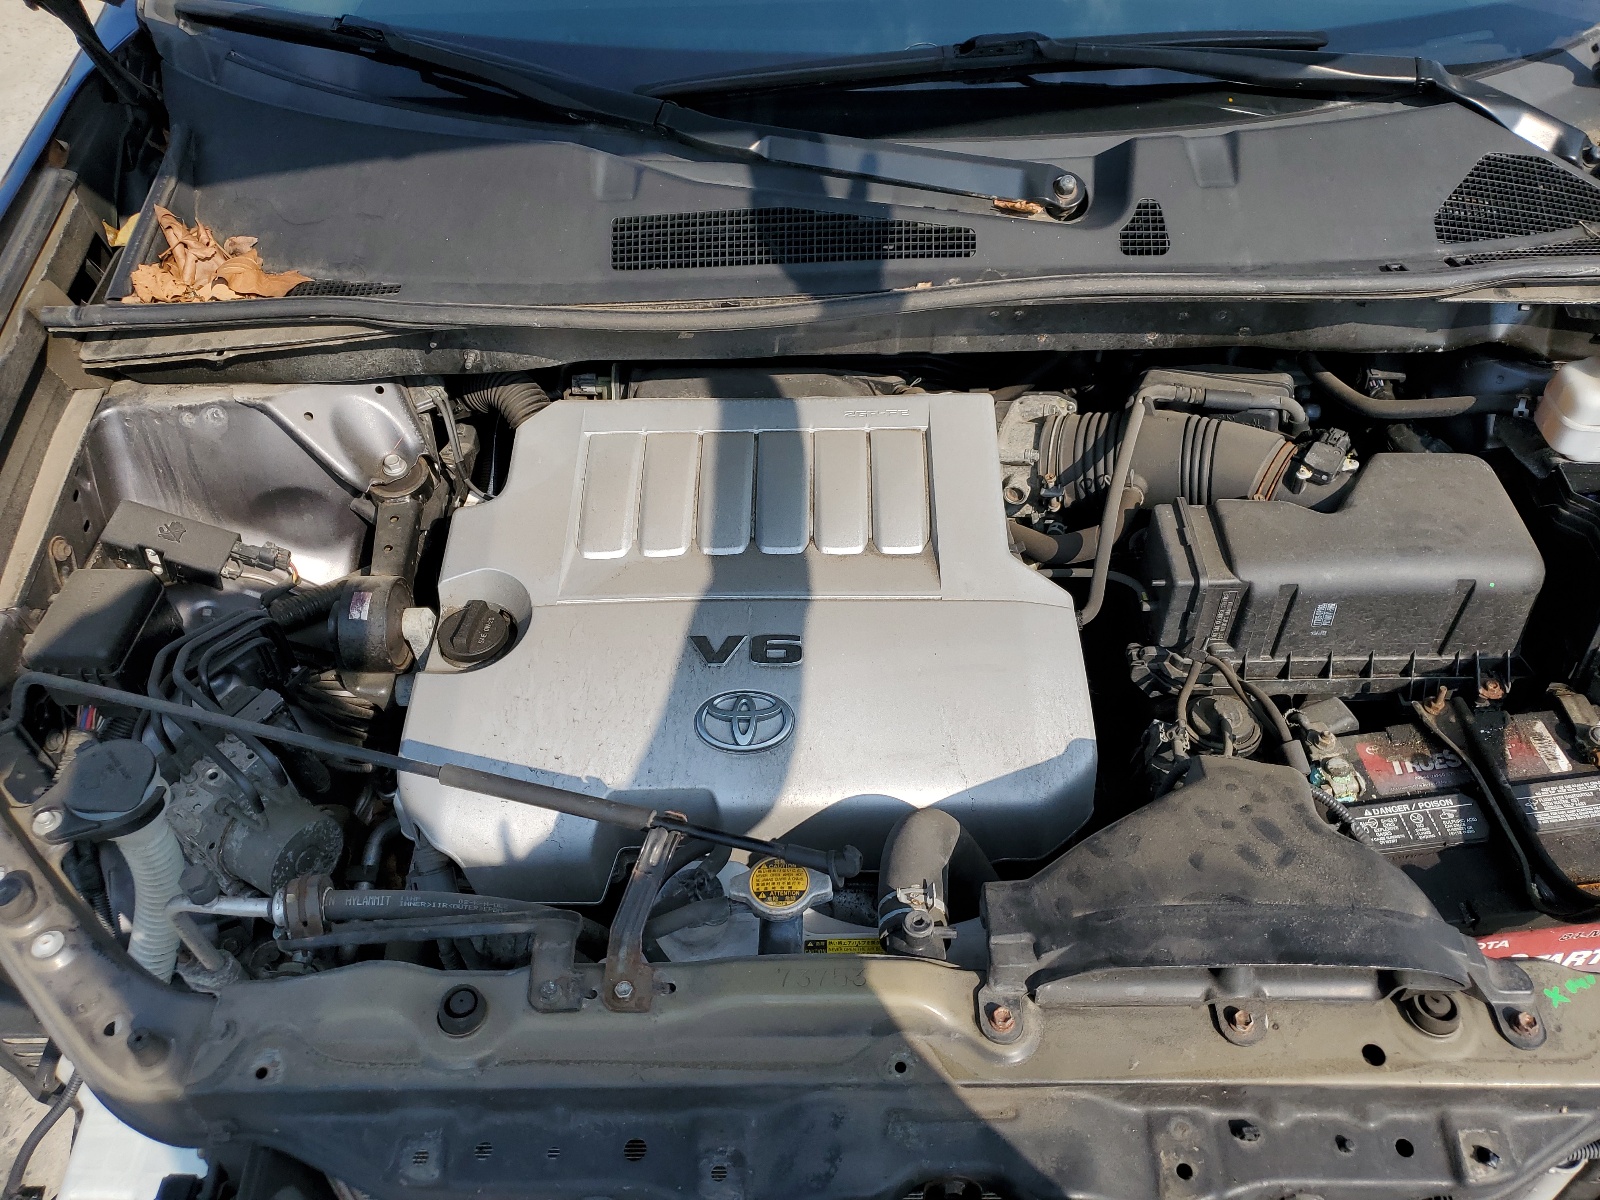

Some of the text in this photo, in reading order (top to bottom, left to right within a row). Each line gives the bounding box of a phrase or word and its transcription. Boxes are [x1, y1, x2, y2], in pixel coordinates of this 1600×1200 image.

[688, 634, 804, 668] V6
[1385, 749, 1463, 776] TRUES
[1371, 804, 1410, 816] DANGER
[1417, 798, 1454, 810] POISON
[1477, 940, 1510, 950] OTA
